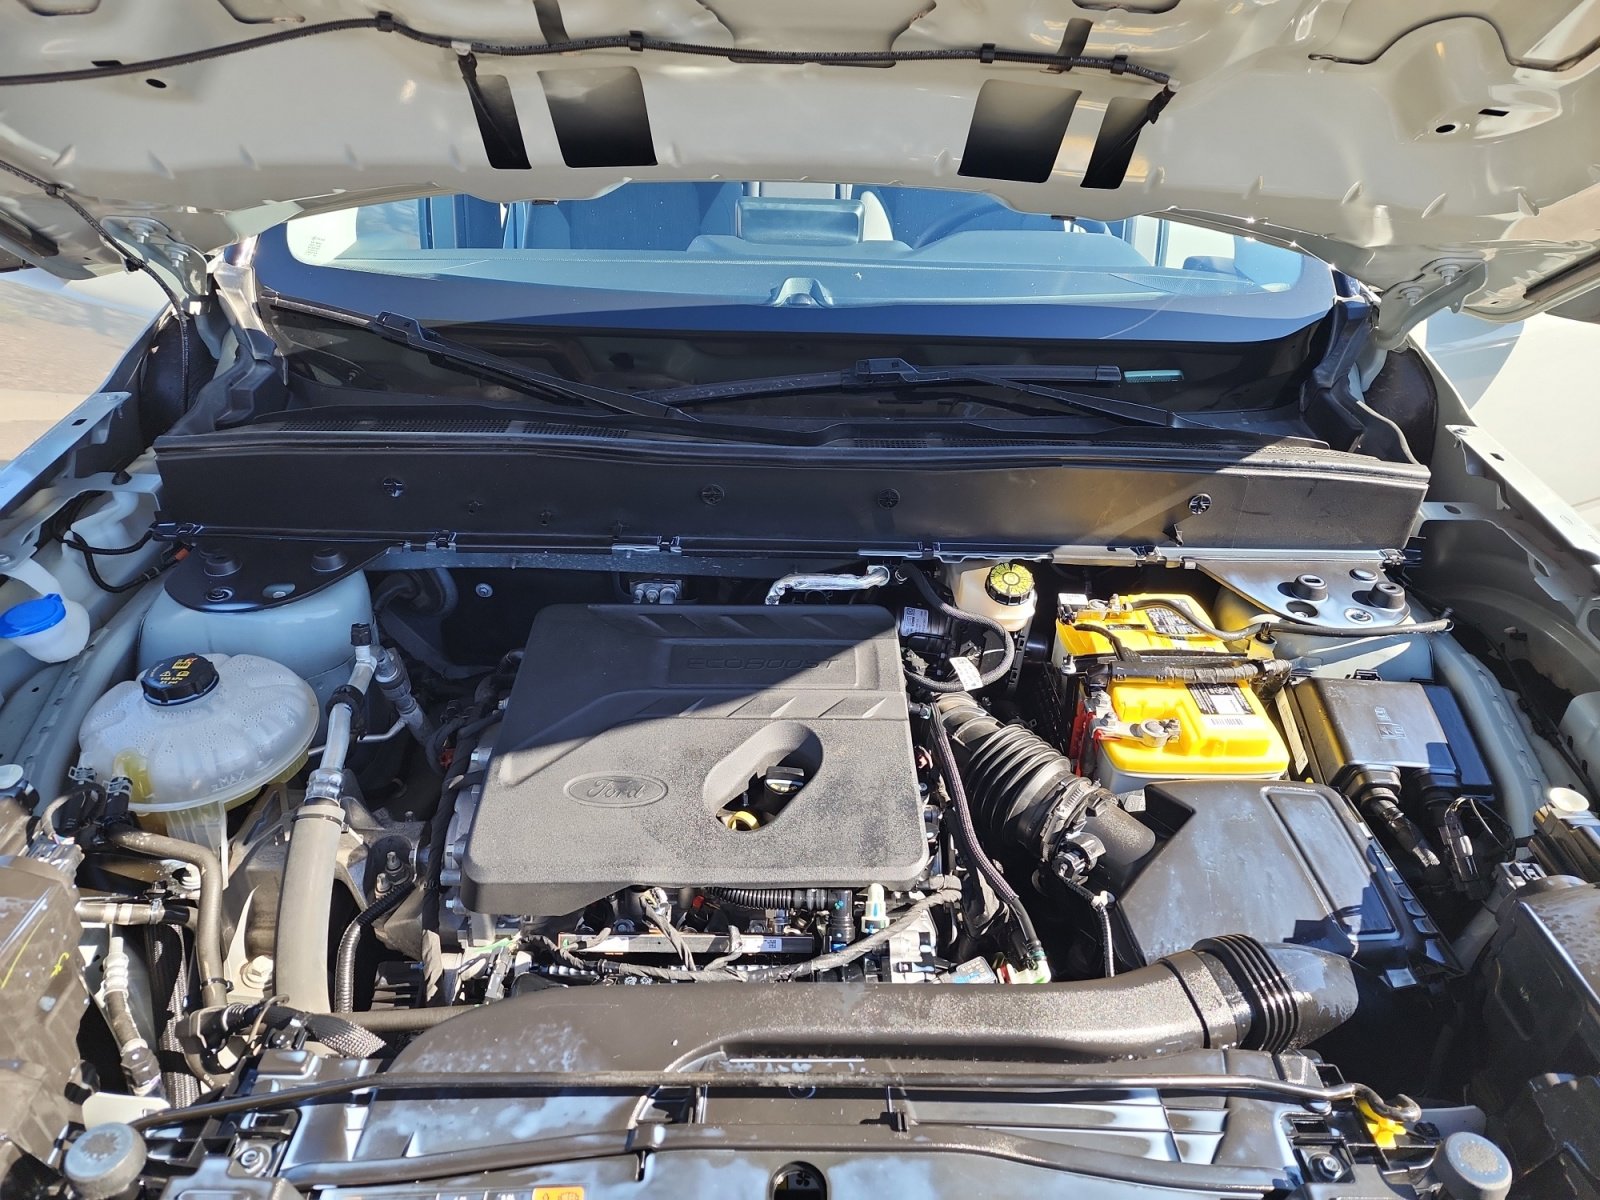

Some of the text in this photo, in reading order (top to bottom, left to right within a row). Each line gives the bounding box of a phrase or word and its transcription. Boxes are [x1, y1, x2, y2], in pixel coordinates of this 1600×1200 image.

[687, 657, 839, 670] ECOBOOST
[219, 770, 247, 787] MAX
[586, 778, 646, 799] Ford
